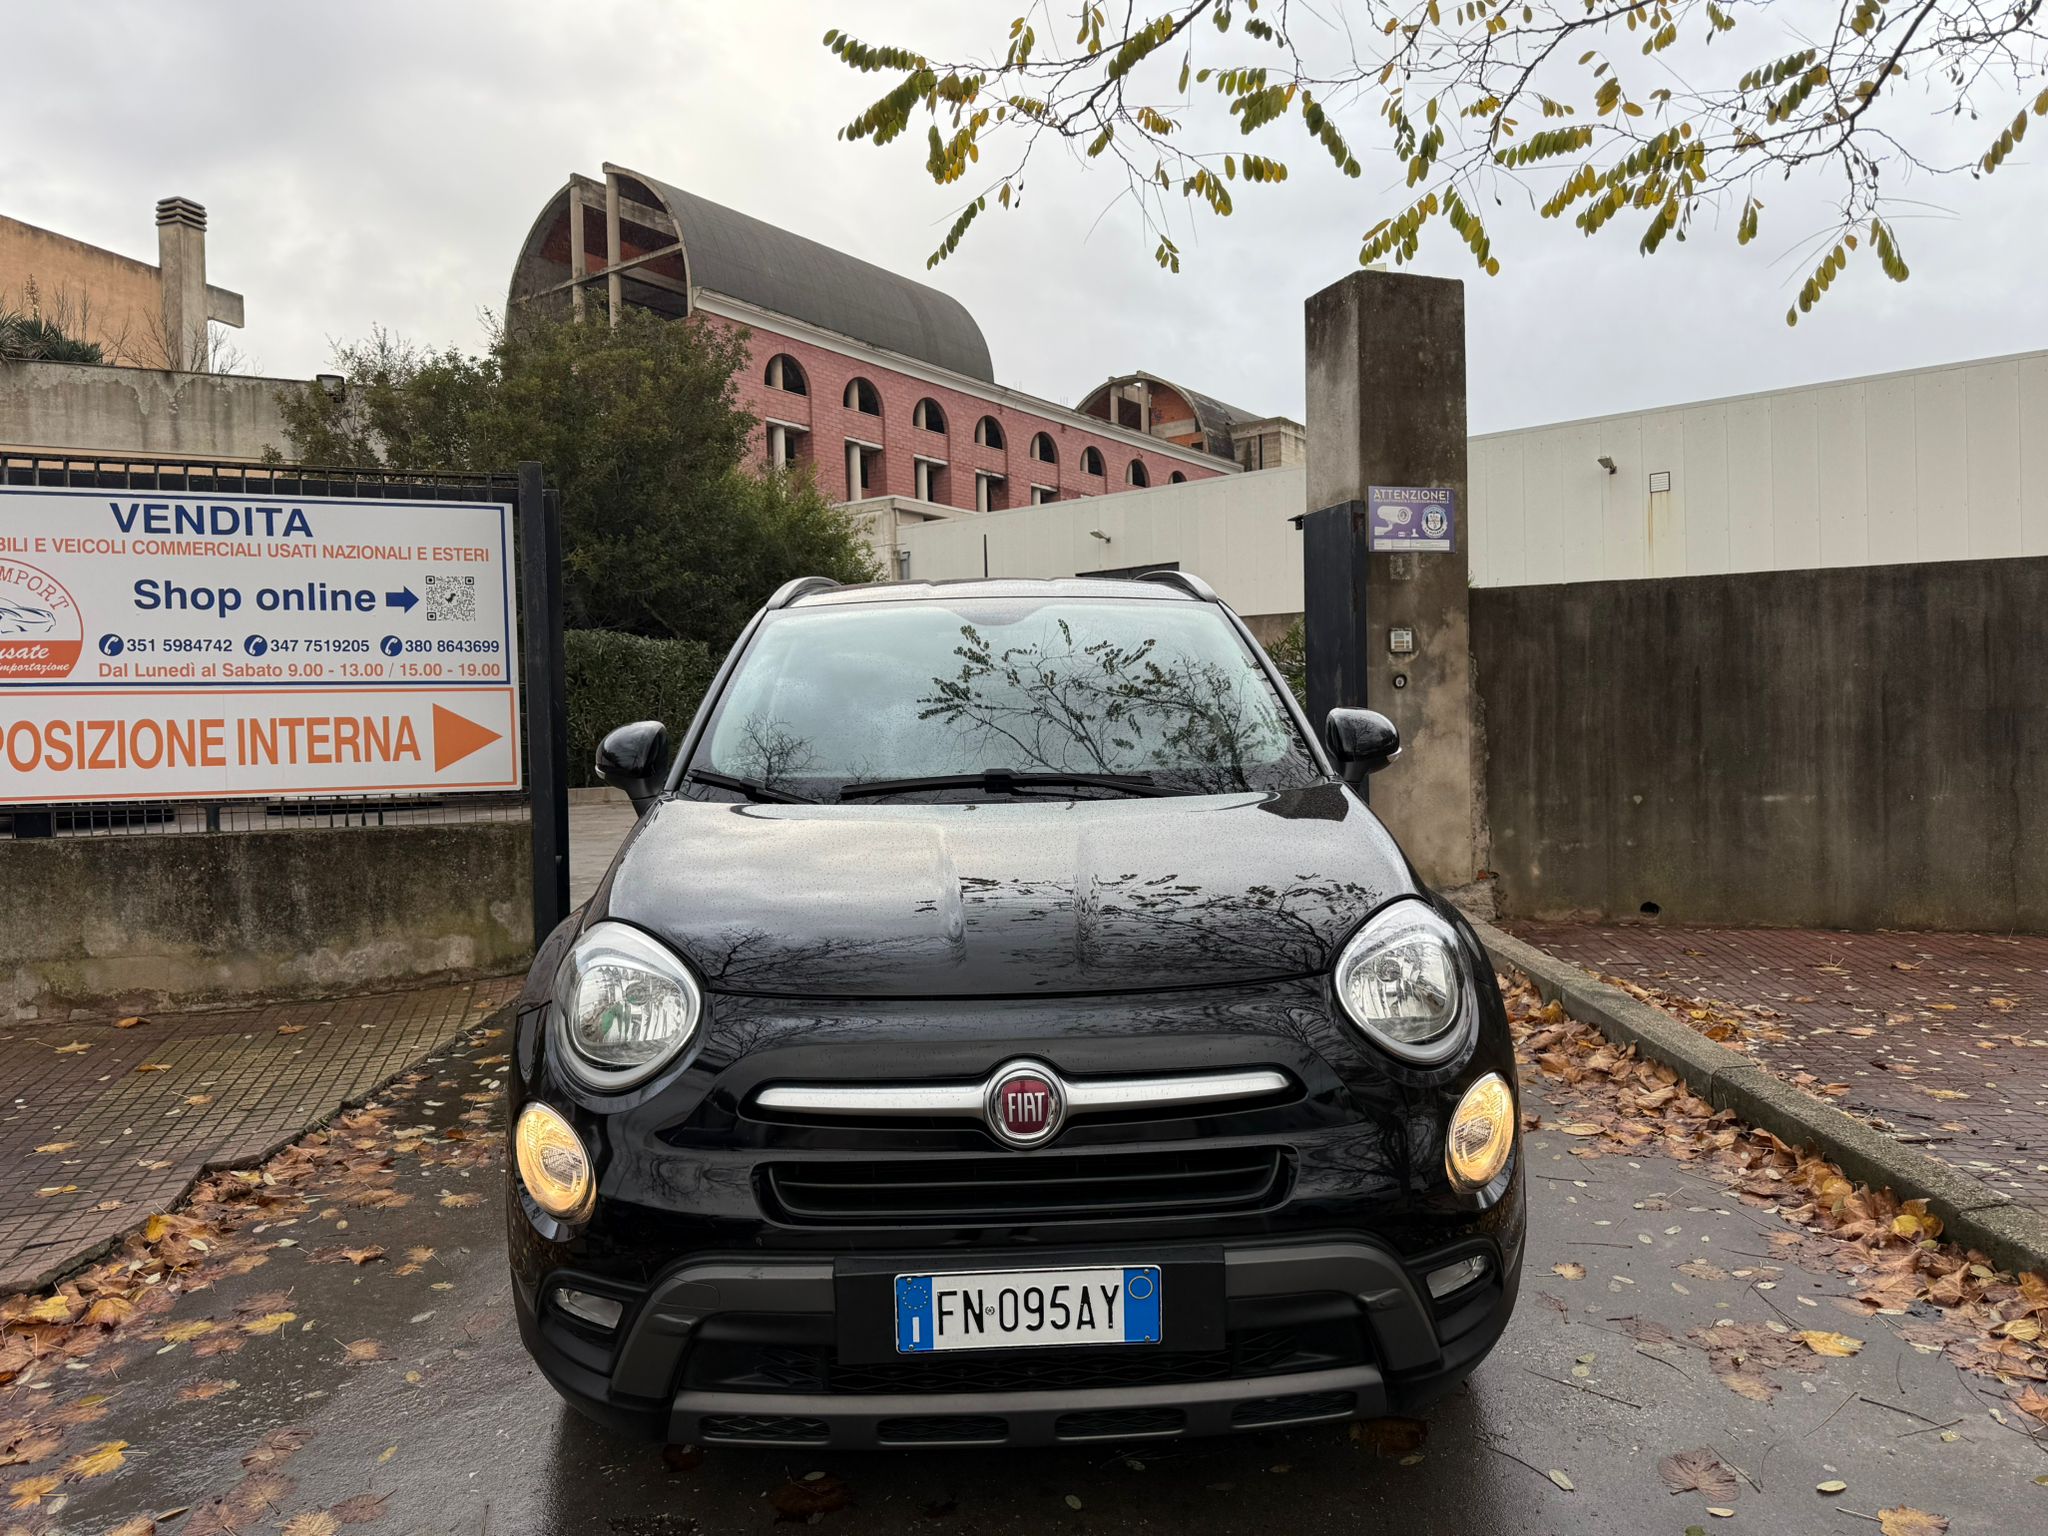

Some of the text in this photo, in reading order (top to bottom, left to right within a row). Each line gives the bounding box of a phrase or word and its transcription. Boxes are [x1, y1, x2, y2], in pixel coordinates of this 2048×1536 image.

[1374, 489, 1449, 500] ATTENZIONE!
[110, 503, 313, 537] VENDITA
[35, 538, 45, 552] E
[52, 538, 127, 555] VEICOLI
[132, 541, 262, 557] COMMERCIALI
[268, 544, 318, 558] USATI
[322, 545, 412, 560] NAZIONALI
[417, 546, 427, 560] E
[432, 547, 489, 561] ESTERI
[134, 579, 375, 618] Shop online
[127, 639, 232, 652] 351 5984742
[271, 640, 369, 652] 347 7519205
[406, 640, 499, 652] 380 8643699
[99, 663, 129, 678] Dal
[135, 663, 196, 678] Lunedì
[202, 663, 218, 678] al
[223, 663, 283, 678] Sabato
[288, 663, 324, 676] 9.00
[340, 664, 384, 677] 13.00
[401, 664, 442, 676] 15.00
[459, 664, 500, 676] 19.00
[0, 715, 422, 773] OSIZIONE INTERNA
[1007, 1092, 1045, 1123] FIAT
